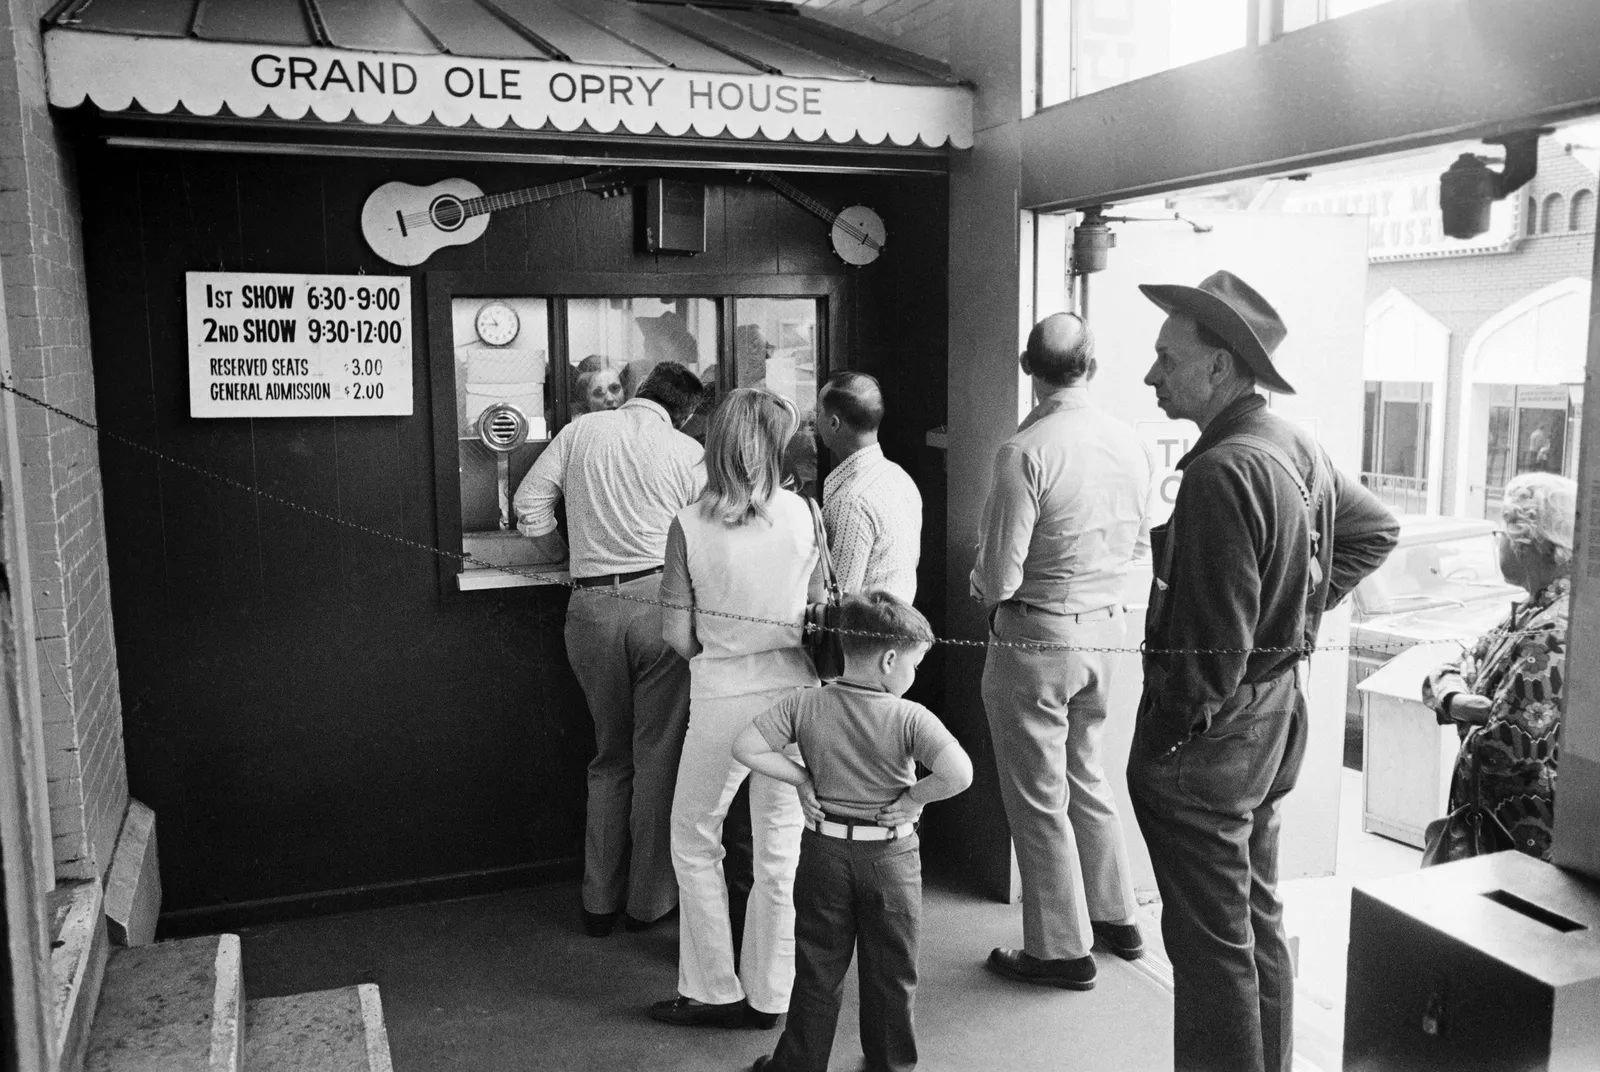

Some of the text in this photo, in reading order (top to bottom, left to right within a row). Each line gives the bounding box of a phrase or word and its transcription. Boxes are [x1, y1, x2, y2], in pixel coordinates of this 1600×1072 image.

[250, 54, 822, 115] GRAND OLE OPRY HOUSE
[206, 284, 233, 309] 1ST
[242, 285, 295, 309] SHOW
[203, 318, 239, 343] 2ND
[243, 319, 297, 343] SHOW
[210, 358, 268, 377] RESERVED
[272, 358, 309, 377] SEATS
[210, 382, 263, 401] GENERAL
[266, 382, 331, 401] ADMISSION
